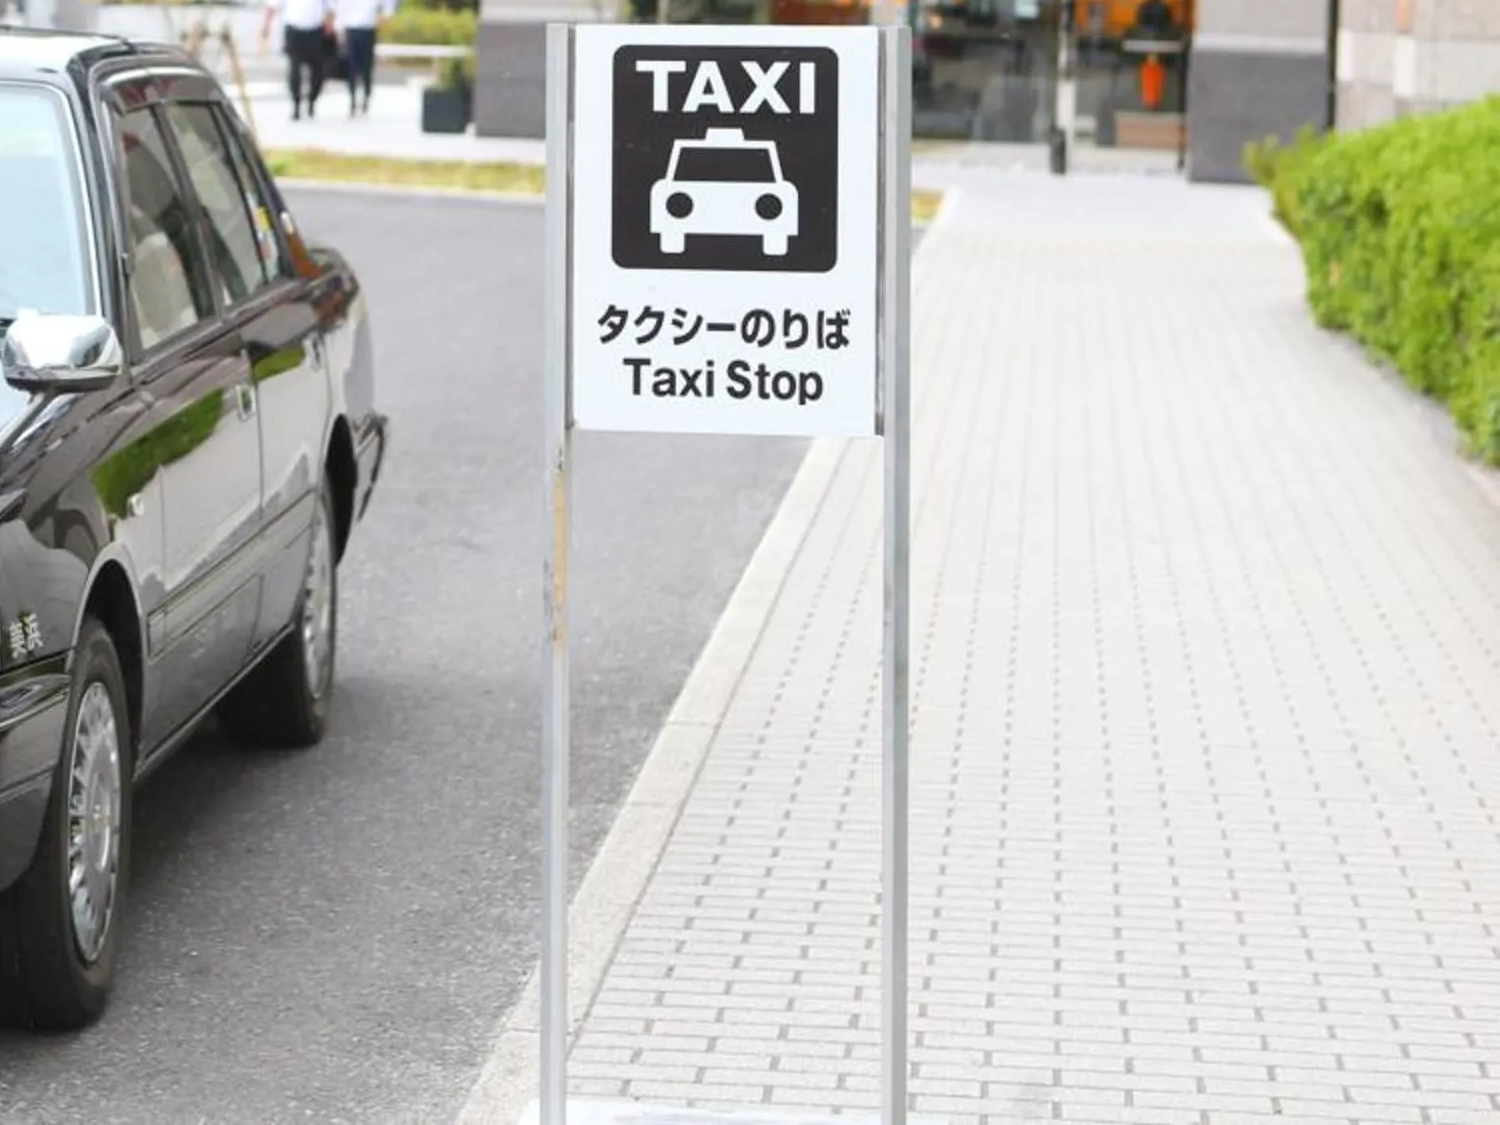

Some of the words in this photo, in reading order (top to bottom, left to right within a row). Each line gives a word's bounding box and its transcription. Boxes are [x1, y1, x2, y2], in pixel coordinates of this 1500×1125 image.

[635, 60, 816, 114] TAXI
[597, 304, 851, 350] タクシーのりば
[622, 358, 715, 397] Taxi
[726, 359, 824, 406] Stop
